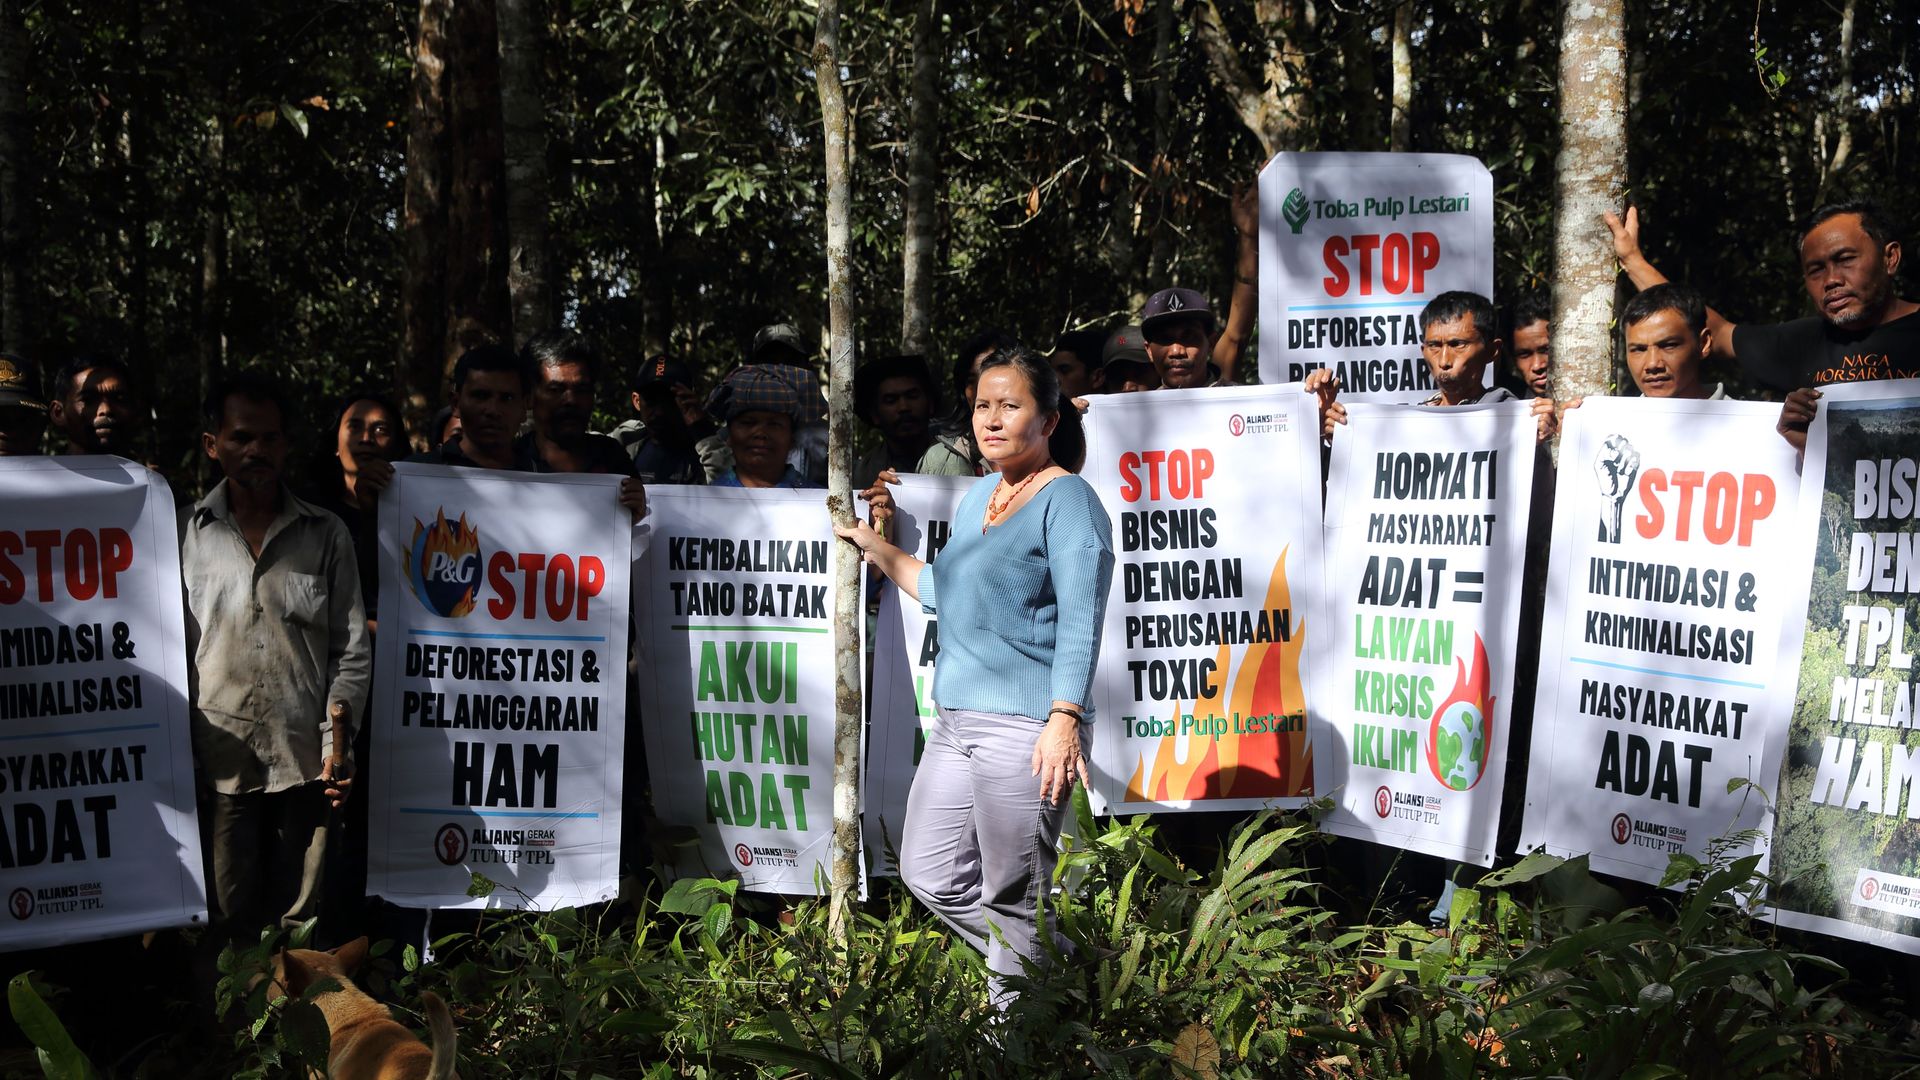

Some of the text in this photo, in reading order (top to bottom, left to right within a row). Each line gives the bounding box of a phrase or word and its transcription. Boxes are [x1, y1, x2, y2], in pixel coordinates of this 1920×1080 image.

[1313, 192, 1469, 221] Toba Pulp Lestari
[1323, 232, 1440, 298] STOP
[1287, 314, 1424, 350] DEFORESTA
[1289, 358, 1438, 394] PANGGAR
[1842, 353, 1890, 369] NAGA
[1246, 414, 1273, 424] ALIANSI
[1246, 423, 1289, 434] TUTUP TPL
[1118, 447, 1215, 503] STOP
[1373, 449, 1497, 500] HORMATI
[1853, 457, 1920, 519] BIS
[1121, 506, 1218, 553] BISNIS
[1367, 512, 1497, 546] MASYARAKAT
[1635, 467, 1776, 547] STOP
[0, 527, 134, 605] STOP
[668, 536, 828, 574] KEMBALIKAN
[1846, 532, 1920, 593] DEN
[426, 551, 606, 622] P&G STOP
[669, 580, 828, 619] TANO BATAK
[1123, 557, 1243, 603] DENGAN
[1357, 554, 1447, 610] ADAT
[1588, 556, 1758, 613] INTIMIDASI &
[0, 621, 137, 668] MIDASI &
[1125, 608, 1291, 650] PERUSAHAAN
[1354, 613, 1454, 666] LAWAN
[1584, 610, 1754, 666] KRIMINALISASI
[1843, 606, 1912, 669] TPL
[405, 643, 600, 684] DEFORESTASI &
[696, 640, 798, 705] AKUI
[1127, 656, 1219, 702] TOXIC
[402, 690, 599, 732] PELANGGARAN
[1354, 669, 1435, 721] KRISIS
[1579, 679, 1749, 741] MASYARAKAT
[1829, 676, 1920, 730] MELA
[690, 711, 809, 766] HUTAN
[1122, 709, 1304, 742] Toba Pulp Lestari
[1352, 723, 1418, 775] IKLIM
[1594, 730, 1712, 809] ADAT
[452, 741, 560, 808] HAM
[705, 769, 811, 832] ADAT
[1393, 806, 1440, 825] TUTUP TPL
[1394, 791, 1424, 807] ALIANSI
[472, 828, 525, 846] ALIANSI
[527, 829, 555, 840] GERAK
[753, 846, 783, 857] ALIANSI
[1632, 833, 1665, 850] TUTUP
[1634, 820, 1687, 837] ALIANSI GERAK
[470, 848, 555, 865] TUTUP TPL
[754, 856, 784, 867] TUTUP
[37, 885, 78, 901] ALIANSI
[37, 897, 103, 916] TUTUP TPL
[1879, 893, 1908, 905] TUTUP
[1909, 899, 1920, 908] TP
[1881, 882, 1911, 896] ALIANSI
